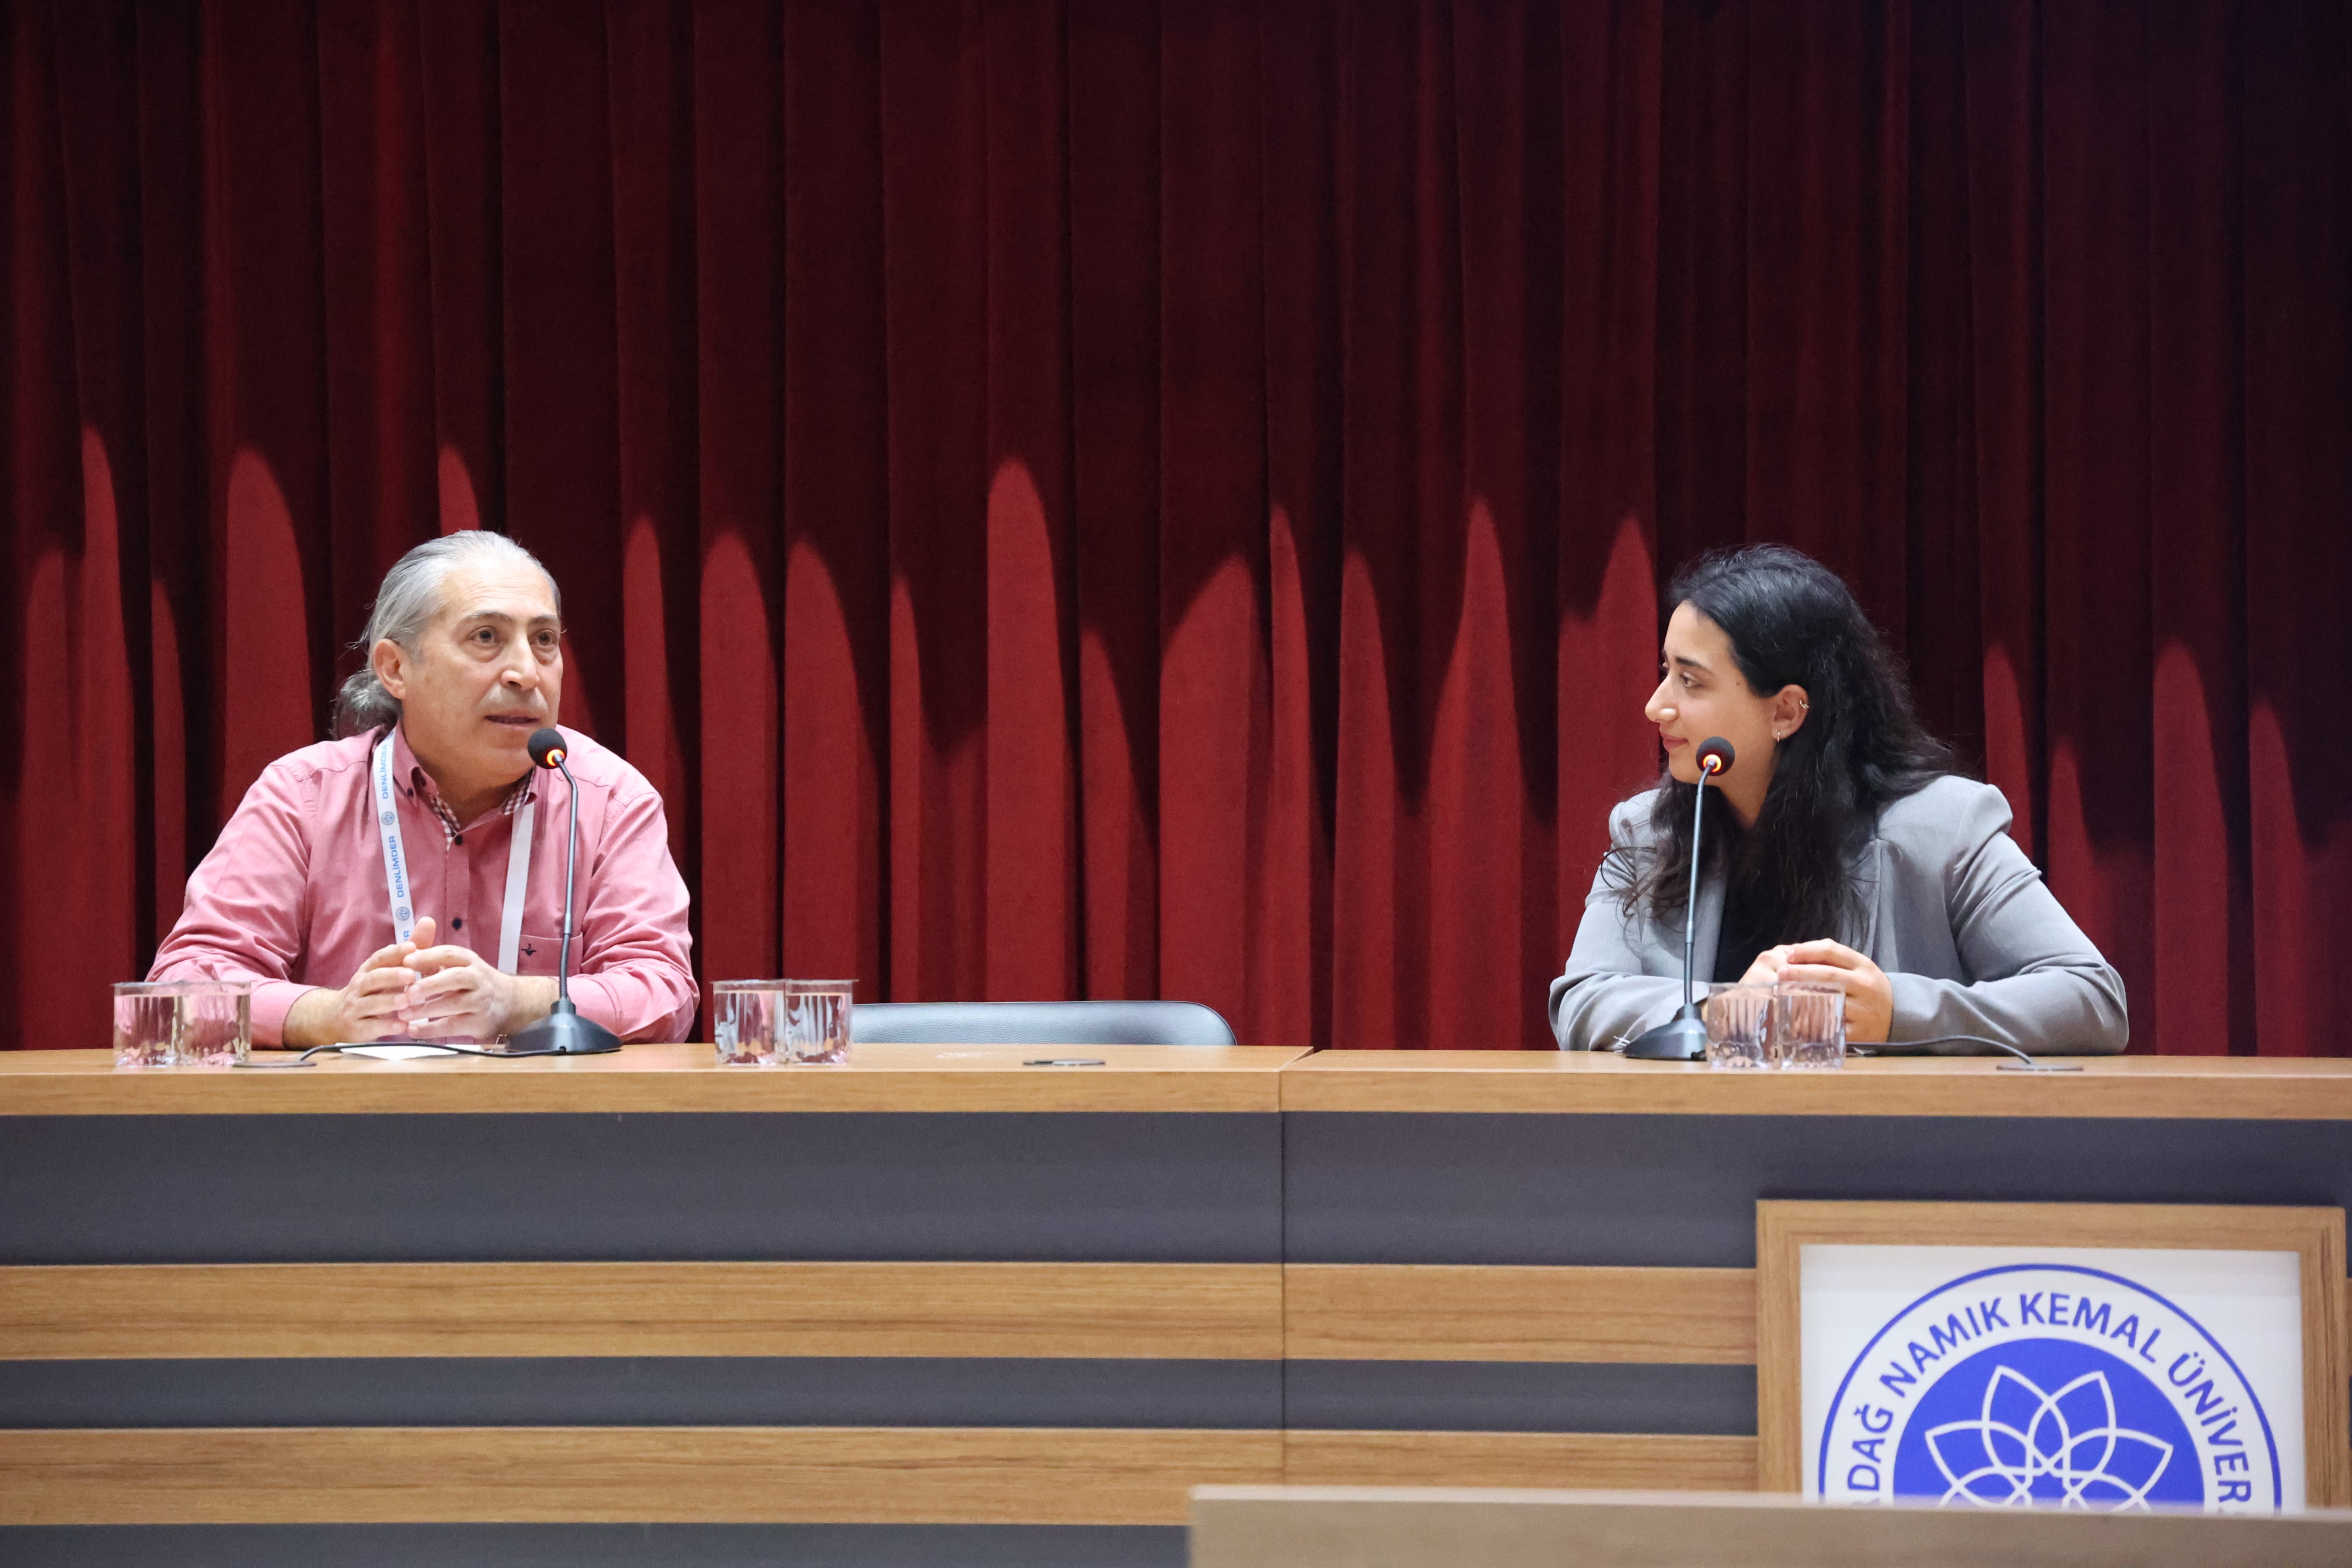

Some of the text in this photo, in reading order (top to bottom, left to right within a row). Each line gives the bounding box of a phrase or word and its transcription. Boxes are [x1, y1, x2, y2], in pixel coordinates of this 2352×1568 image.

[379, 744, 388, 799] DENLİMDER
[389, 835, 404, 897] DENLİMDER
[1847, 1292, 2252, 1515] DAĞ NAMIK KEMAL ÜNİVER
